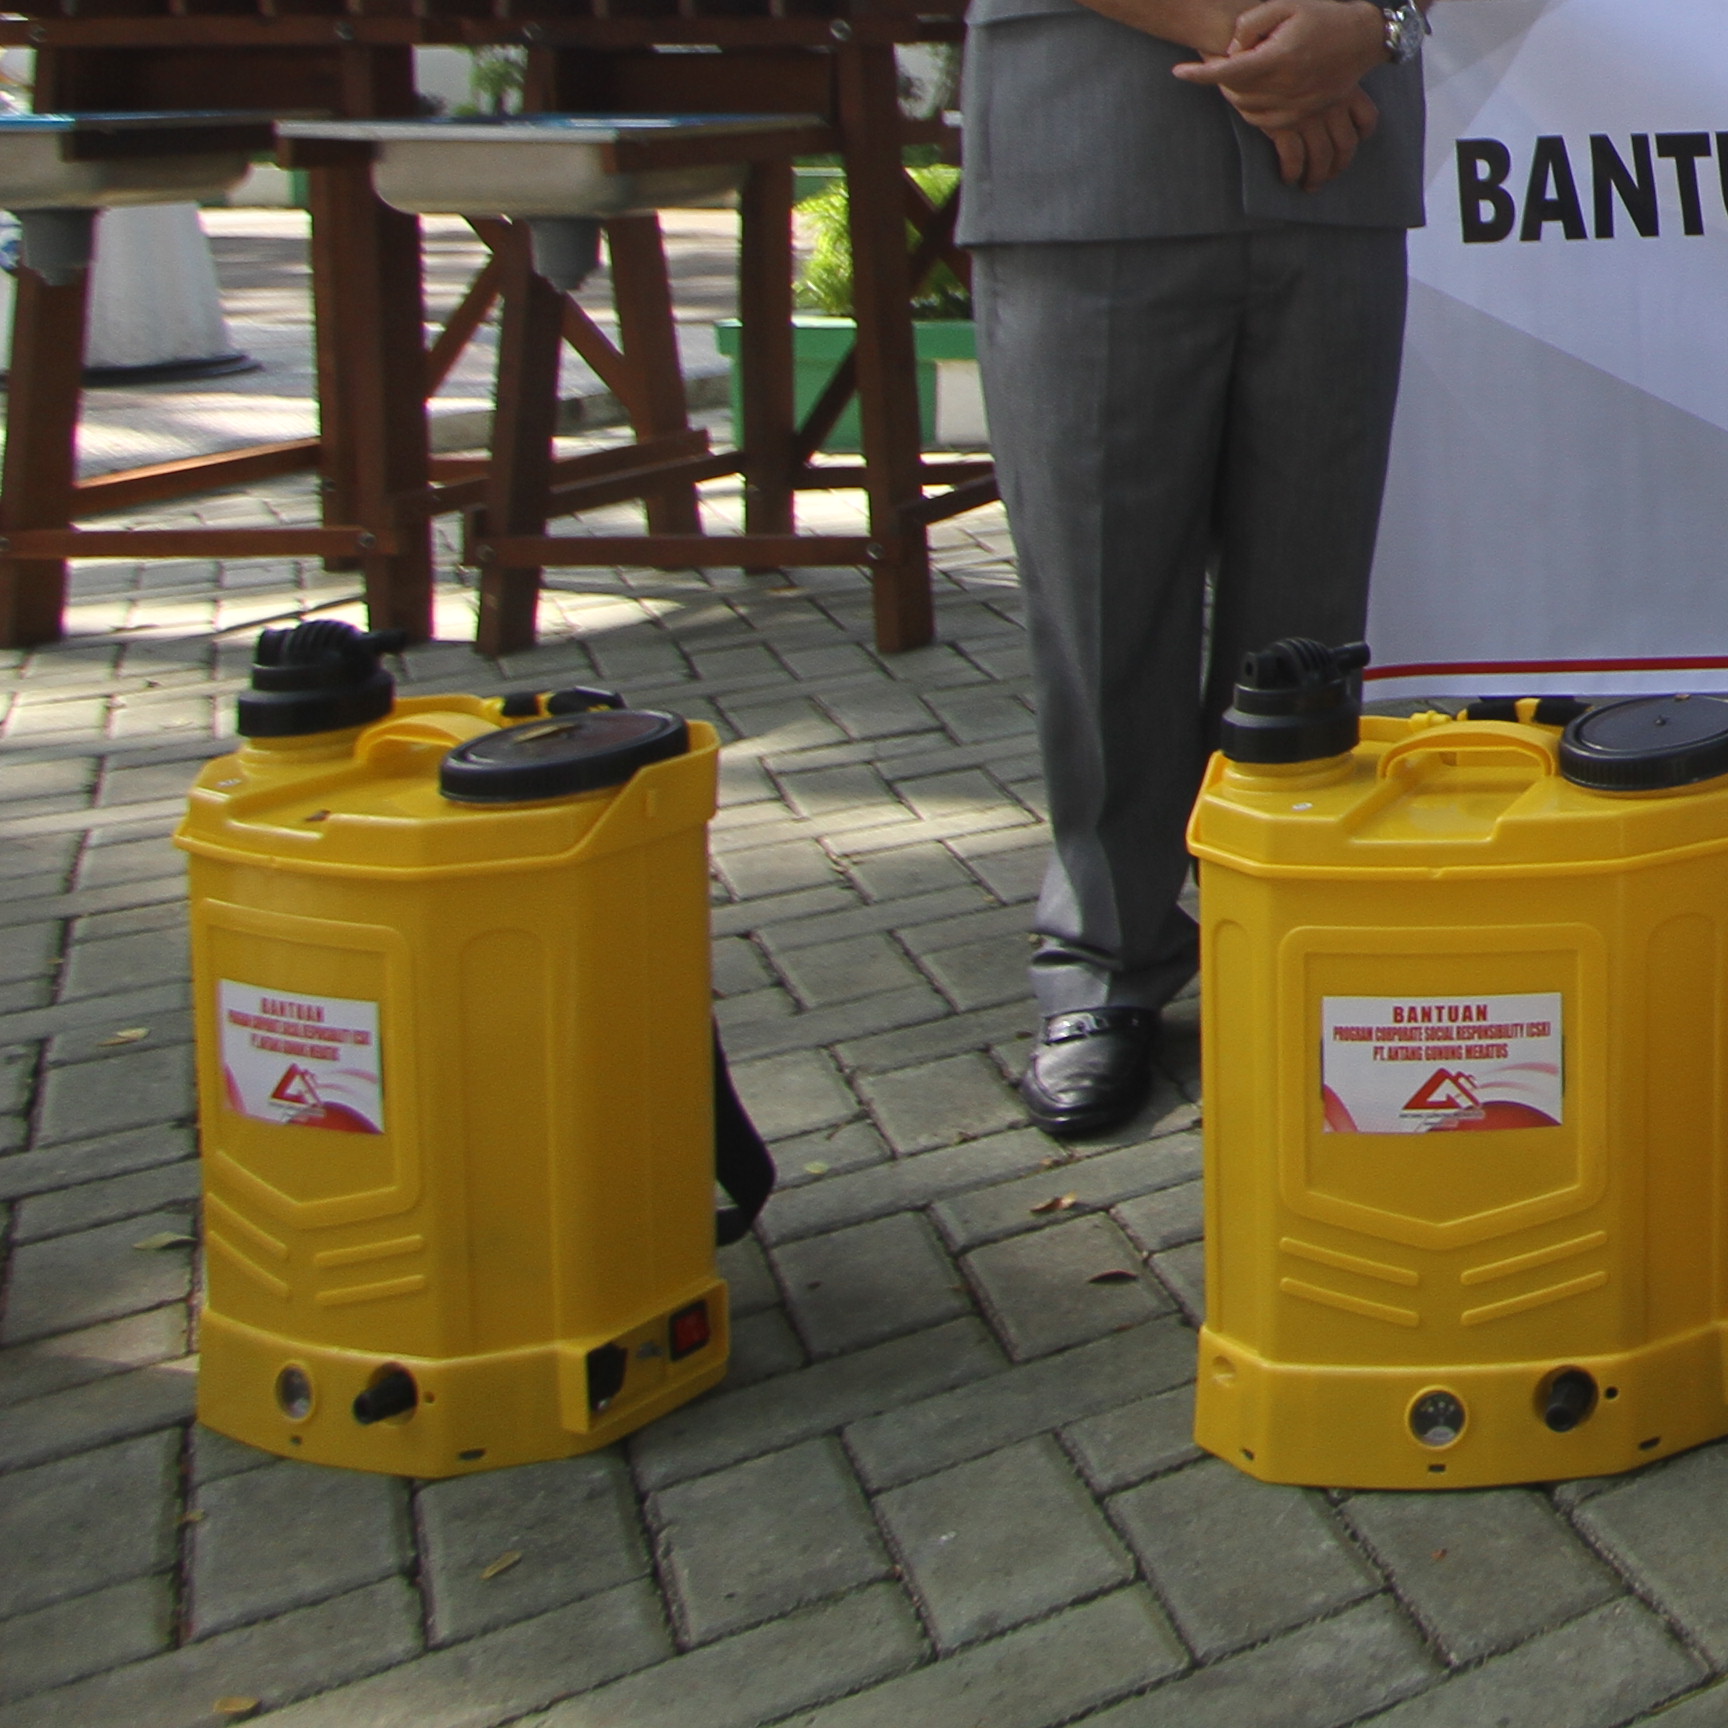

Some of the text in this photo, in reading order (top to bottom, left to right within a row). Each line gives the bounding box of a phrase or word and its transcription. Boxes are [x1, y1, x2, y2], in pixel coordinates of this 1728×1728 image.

[1393, 1004, 1489, 1024] BANTUAN
[1387, 1046, 1422, 1061] ANTANG
[1424, 1045, 1463, 1061] GUNUNG
[1464, 1043, 1509, 1060] MERATUS
